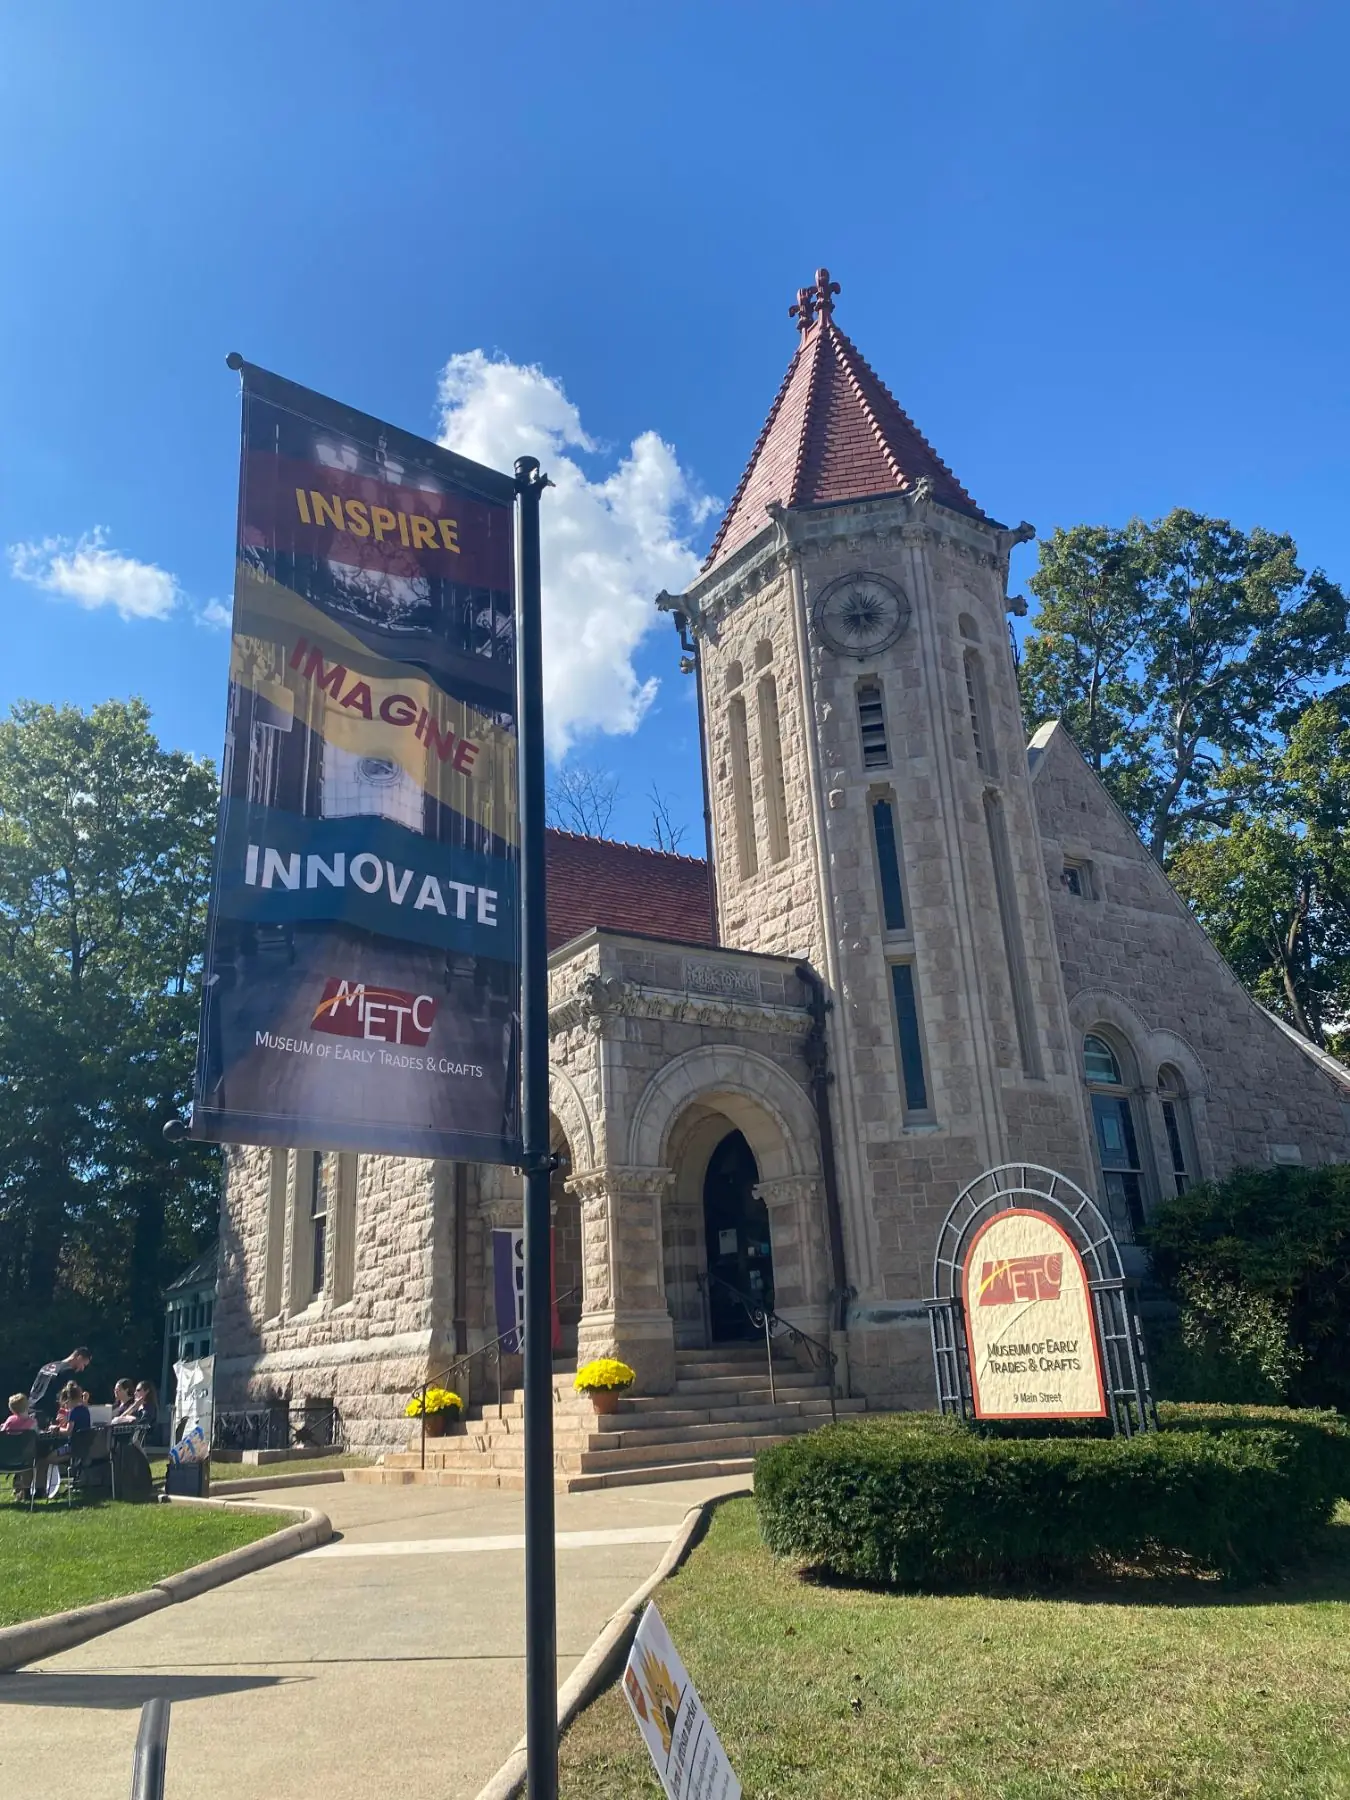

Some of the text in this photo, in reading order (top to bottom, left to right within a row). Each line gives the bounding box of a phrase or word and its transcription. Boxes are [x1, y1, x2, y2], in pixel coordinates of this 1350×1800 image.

[295, 488, 460, 554] INSPIRE
[288, 637, 480, 777] IMAGINE
[244, 844, 498, 927] INNOVATE
[329, 980, 433, 1043] METC
[255, 1030, 483, 1078] MUSEUM OF EARLY TRADES & CRAFTS
[990, 1255, 1061, 1303] METC
[987, 1338, 1078, 1357] MUSEUM OF EARLY
[989, 1357, 1081, 1374] TRADES & CRAFTS
[1013, 1391, 1062, 1403] 9 Main Street
